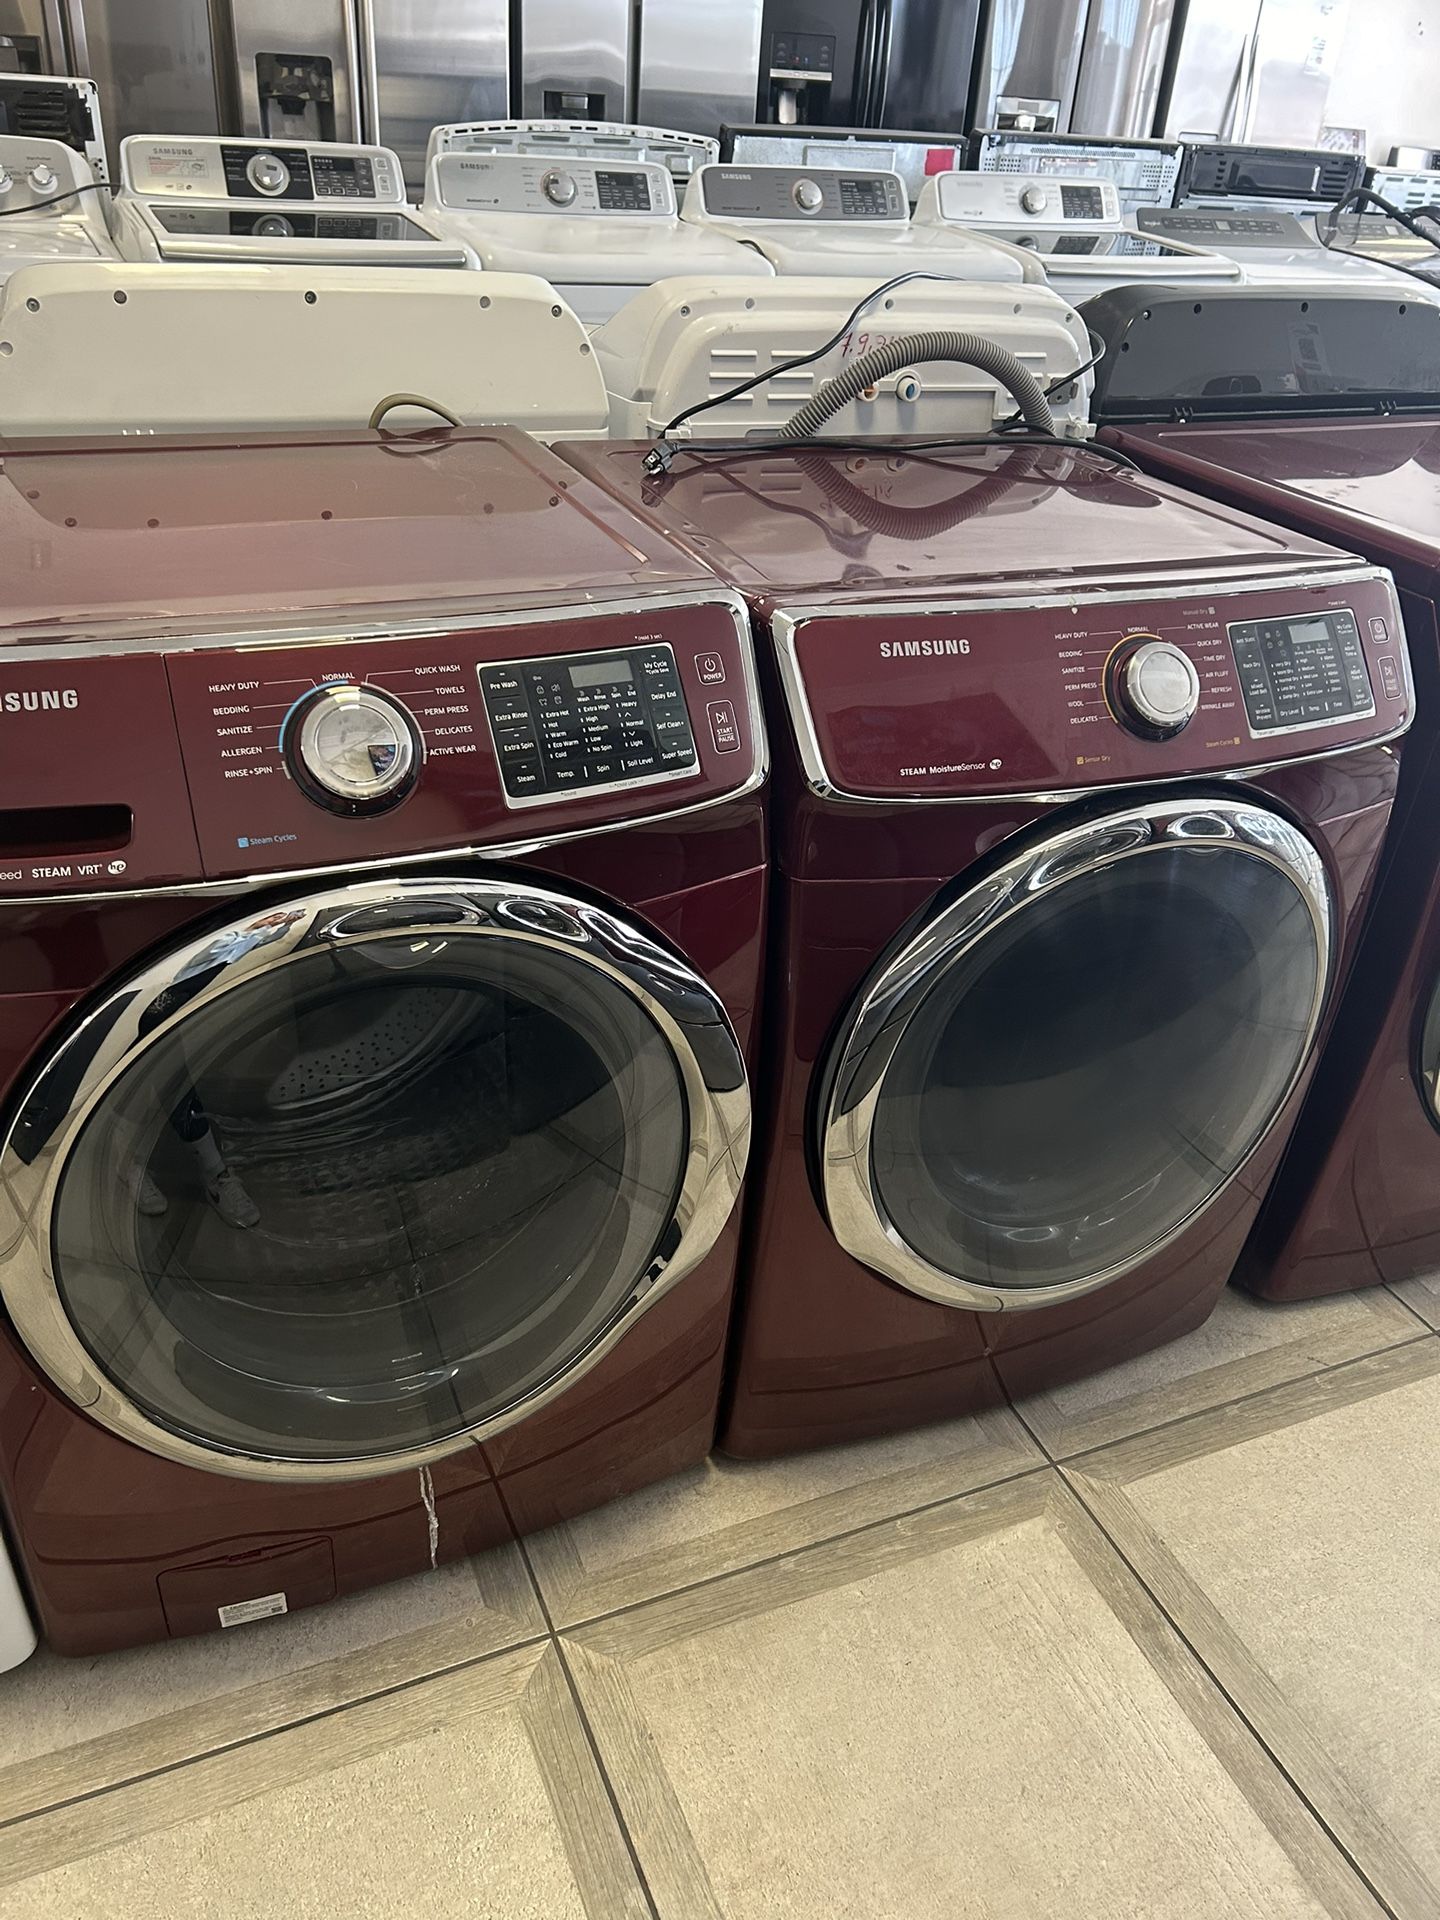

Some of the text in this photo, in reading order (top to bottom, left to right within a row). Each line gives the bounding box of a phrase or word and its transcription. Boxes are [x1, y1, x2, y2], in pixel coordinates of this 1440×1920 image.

[880, 639, 970, 658] SAMSUNG
[1058, 650, 1083, 658] BEDDING
[414, 664, 461, 675] QUICK WASH
[643, 660, 668, 670] My Cycle
[1061, 666, 1086, 674] SANITIZE
[322, 672, 356, 682] NORMAL
[703, 672, 722, 680] POWER
[208, 681, 260, 693] HEAVY DUTY
[500, 680, 518, 689] Wash
[1080, 682, 1097, 690] PRESS
[435, 685, 465, 695] TOWELS
[651, 690, 677, 700] Delay End
[0, 689, 79, 712] SUNG
[213, 705, 250, 716] BEDDING
[424, 704, 469, 715] PERM PRESS
[597, 703, 611, 711] High
[494, 711, 528, 722] Extra Rinse
[545, 709, 570, 719] Extra Hot
[585, 715, 599, 723] High
[625, 719, 644, 727] Normal
[1070, 715, 1098, 724] DELICATES
[216, 725, 254, 736] SANITIZE
[434, 725, 473, 736] DELICATES
[656, 722, 667, 730] Self
[716, 726, 733, 735] START
[563, 739, 579, 747] Warm
[630, 740, 644, 748] Light
[718, 735, 735, 743] PAUSE
[429, 744, 477, 756] ACTIVE WEAR
[503, 741, 535, 752] Extra Spin
[592, 744, 613, 753] No Spin
[220, 746, 263, 758] ALLERGEN
[554, 751, 568, 759] Cold
[661, 747, 693, 761] Super Speed
[627, 757, 654, 768] Soil Level
[1101, 754, 1112, 762] Dry
[596, 764, 611, 773] Spin
[900, 767, 927, 776] STEAM
[929, 762, 986, 774] MoistureSensor
[517, 773, 536, 783] Steam
[557, 770, 575, 780] Temp.
[250, 834, 298, 846] Steam Cycles
[31, 866, 72, 879] STEAM
